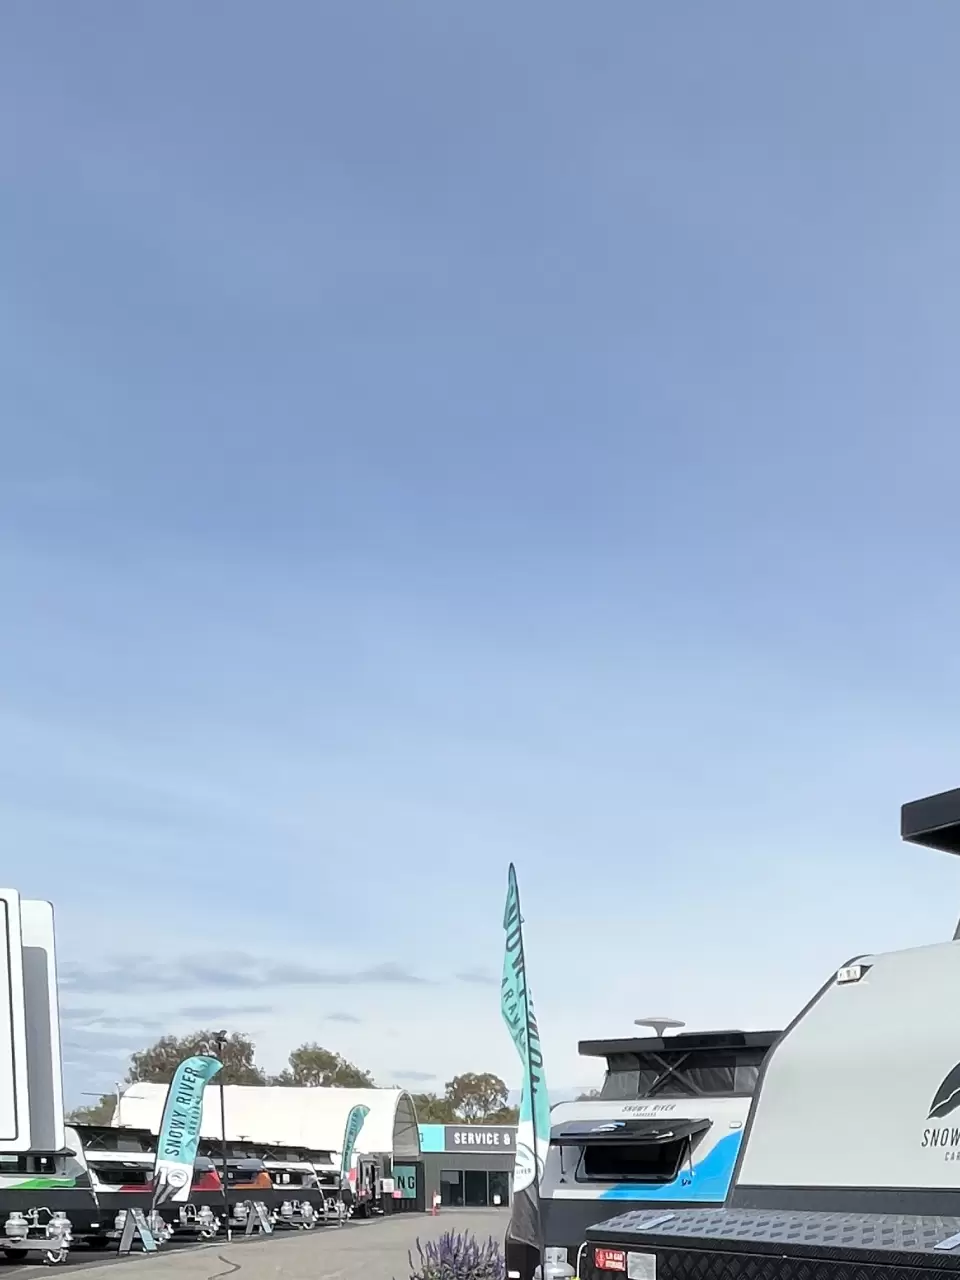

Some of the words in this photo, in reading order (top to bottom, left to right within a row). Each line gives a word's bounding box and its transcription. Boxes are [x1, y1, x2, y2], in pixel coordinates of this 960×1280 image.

[165, 1109, 187, 1157] SNOWY
[176, 1066, 200, 1106] RIVER
[454, 1131, 500, 1145] SERVICE
[503, 1133, 511, 1146] &
